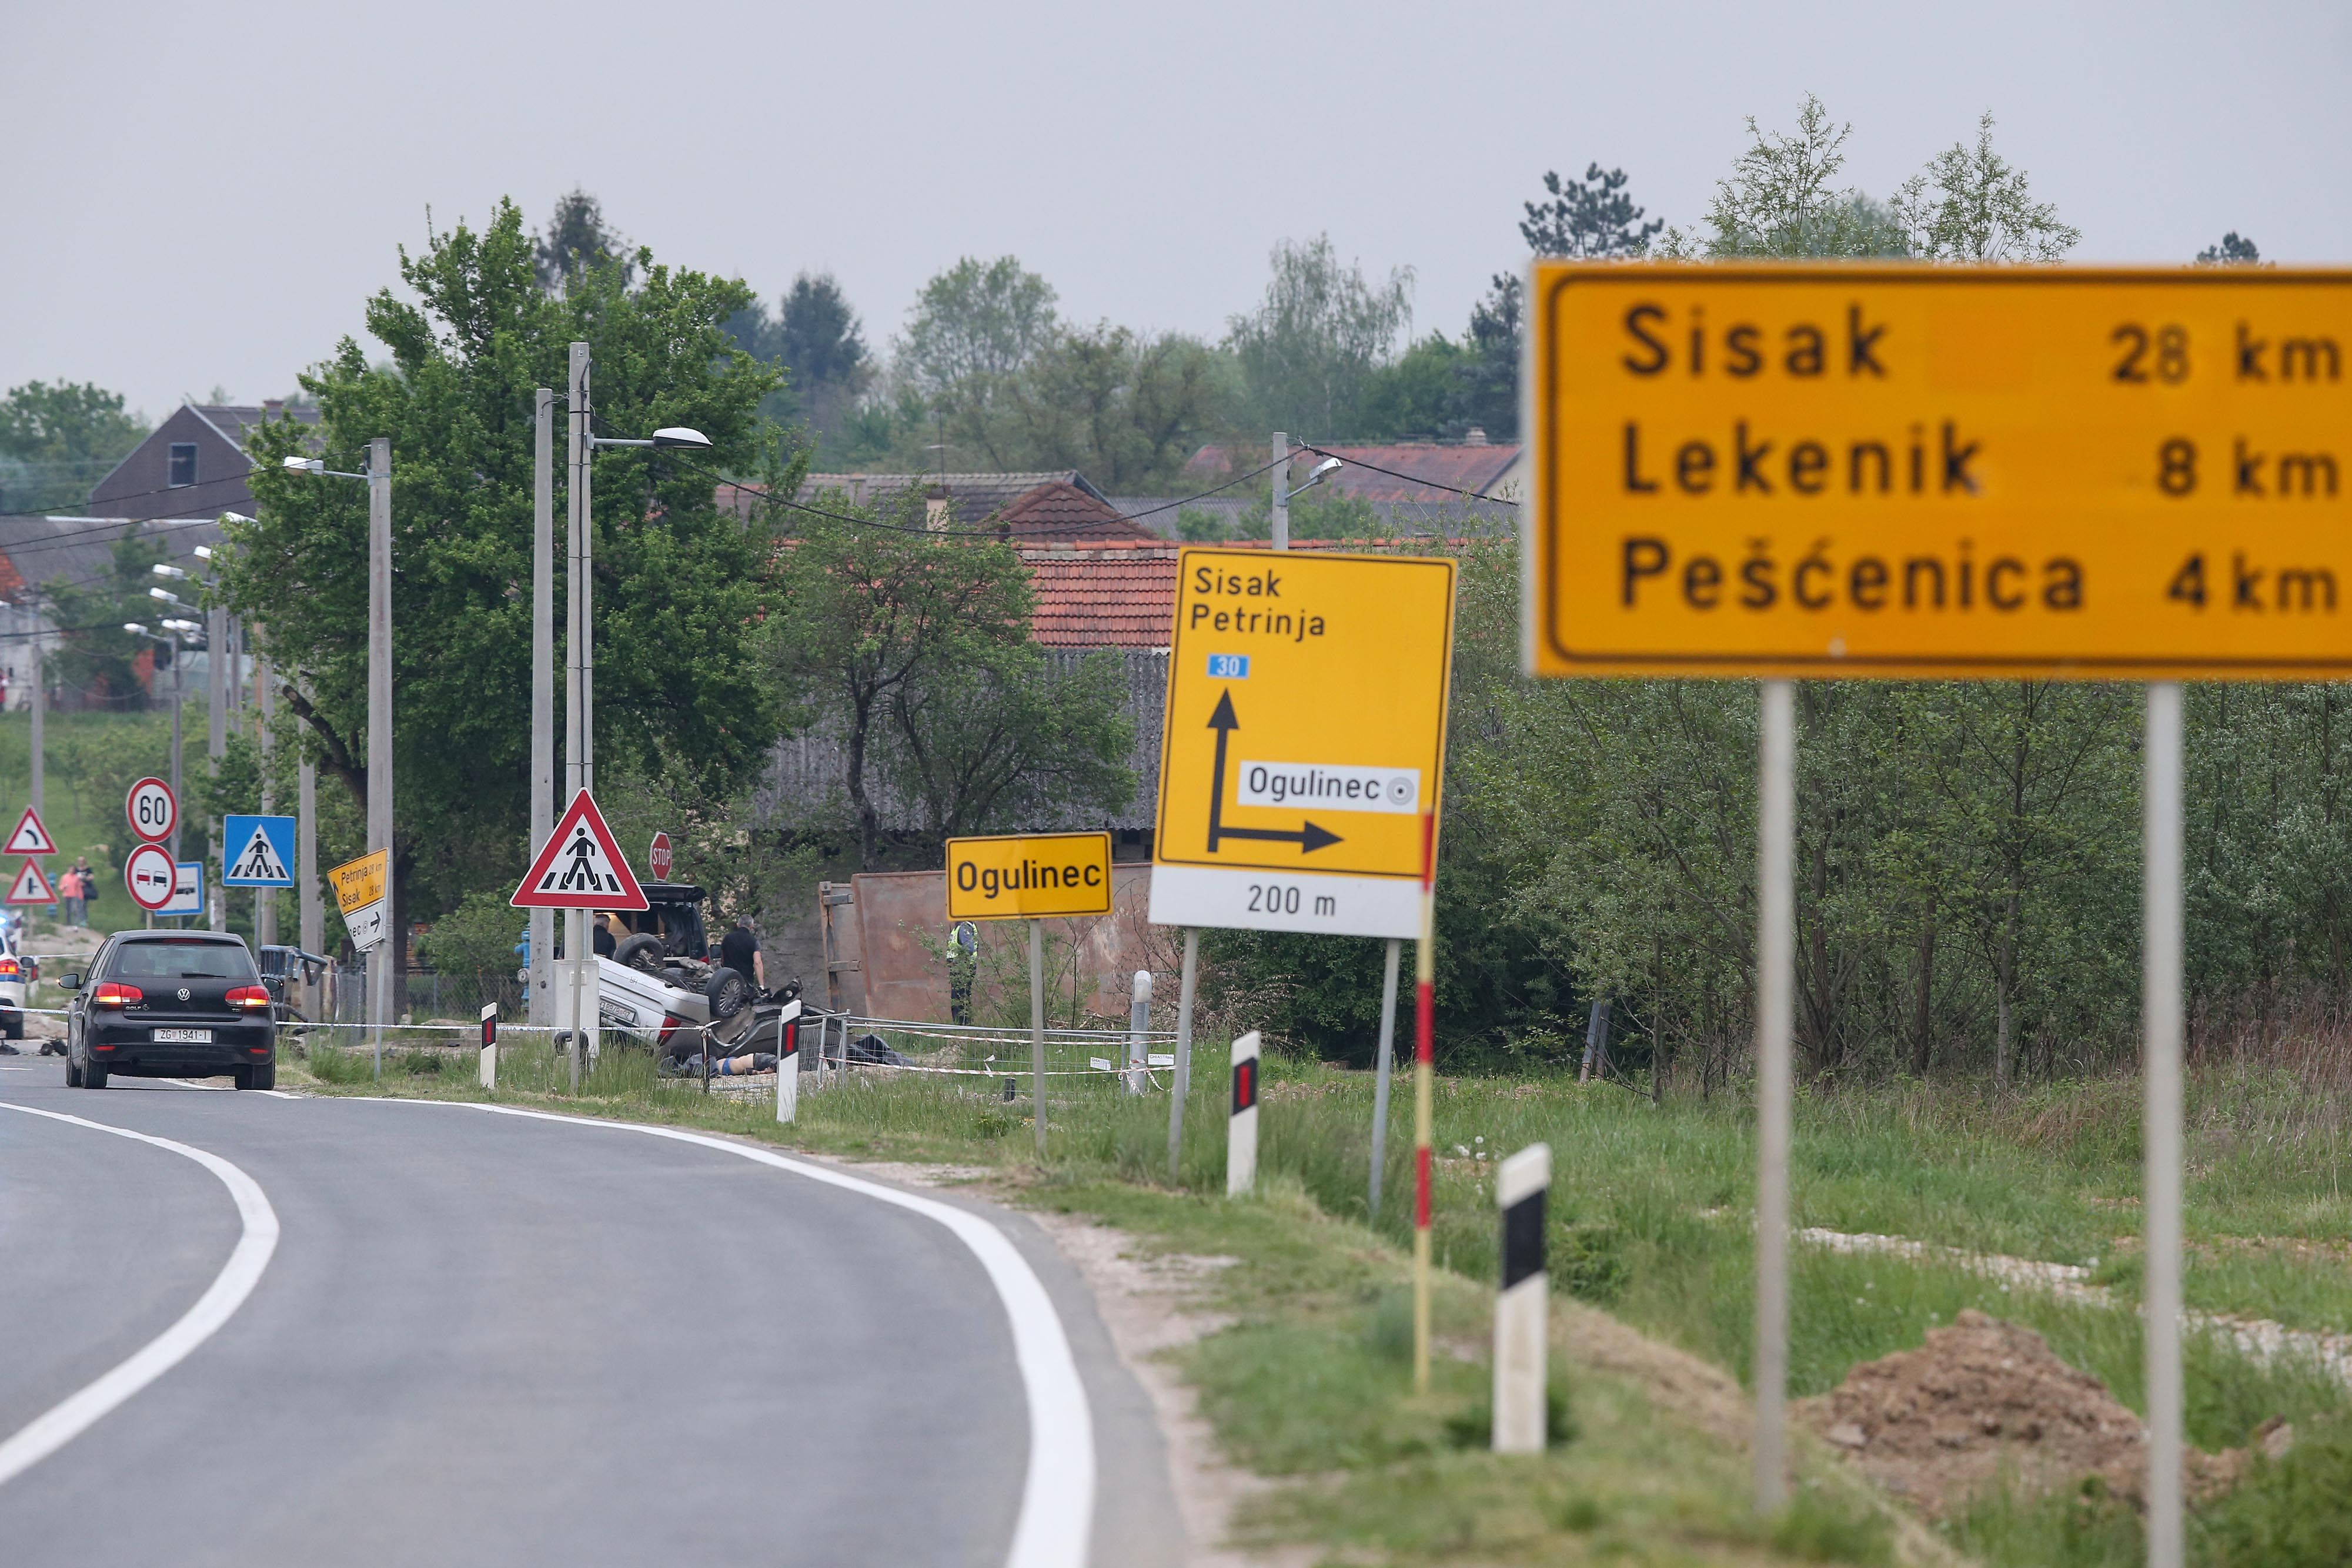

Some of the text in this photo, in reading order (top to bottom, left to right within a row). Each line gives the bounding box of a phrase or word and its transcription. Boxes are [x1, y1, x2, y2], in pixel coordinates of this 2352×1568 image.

[1621, 302, 2343, 386] Sisak 28 km
[1622, 420, 2339, 499] Lekenik 8 km
[1194, 566, 1282, 597] Sisak
[1621, 536, 2338, 611] Pešćenica 4 km
[1191, 603, 1326, 643] Petrinja
[1216, 656, 1241, 676] 30
[1250, 767, 1381, 803] Ogulinec
[140, 795, 165, 826] 60
[653, 847, 671, 866] STOP
[341, 864, 368, 886] Petrinja
[957, 859, 1101, 900] Ogulinec
[342, 888, 360, 907] Sisak
[1248, 885, 1335, 916] 200 m
[161, 1029, 172, 1039] ZG
